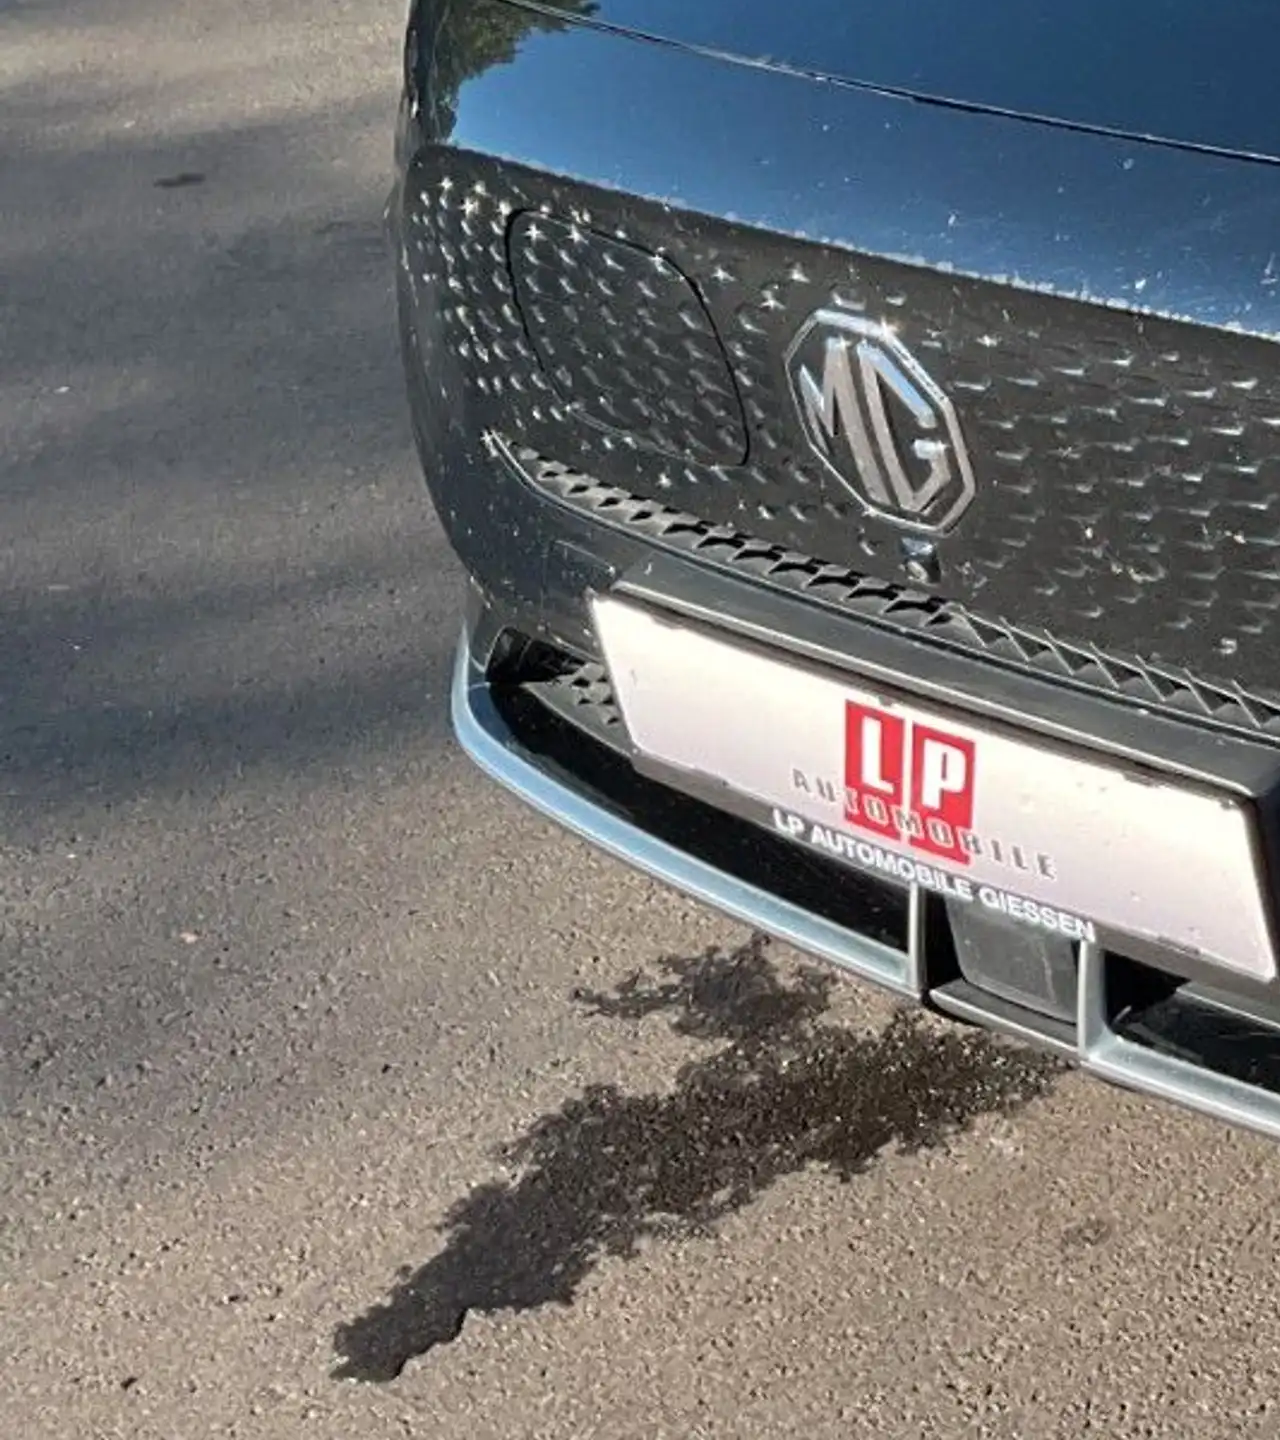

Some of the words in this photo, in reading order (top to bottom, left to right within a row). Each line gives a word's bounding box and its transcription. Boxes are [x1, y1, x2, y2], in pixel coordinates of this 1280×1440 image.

[797, 335, 953, 513] MG
[791, 766, 1058, 882] AUTOMOBILE
[859, 714, 968, 810] LP
[772, 807, 806, 834] LP
[810, 824, 974, 902] AUTOMOBILE
[978, 886, 1097, 945] GIESSEN
